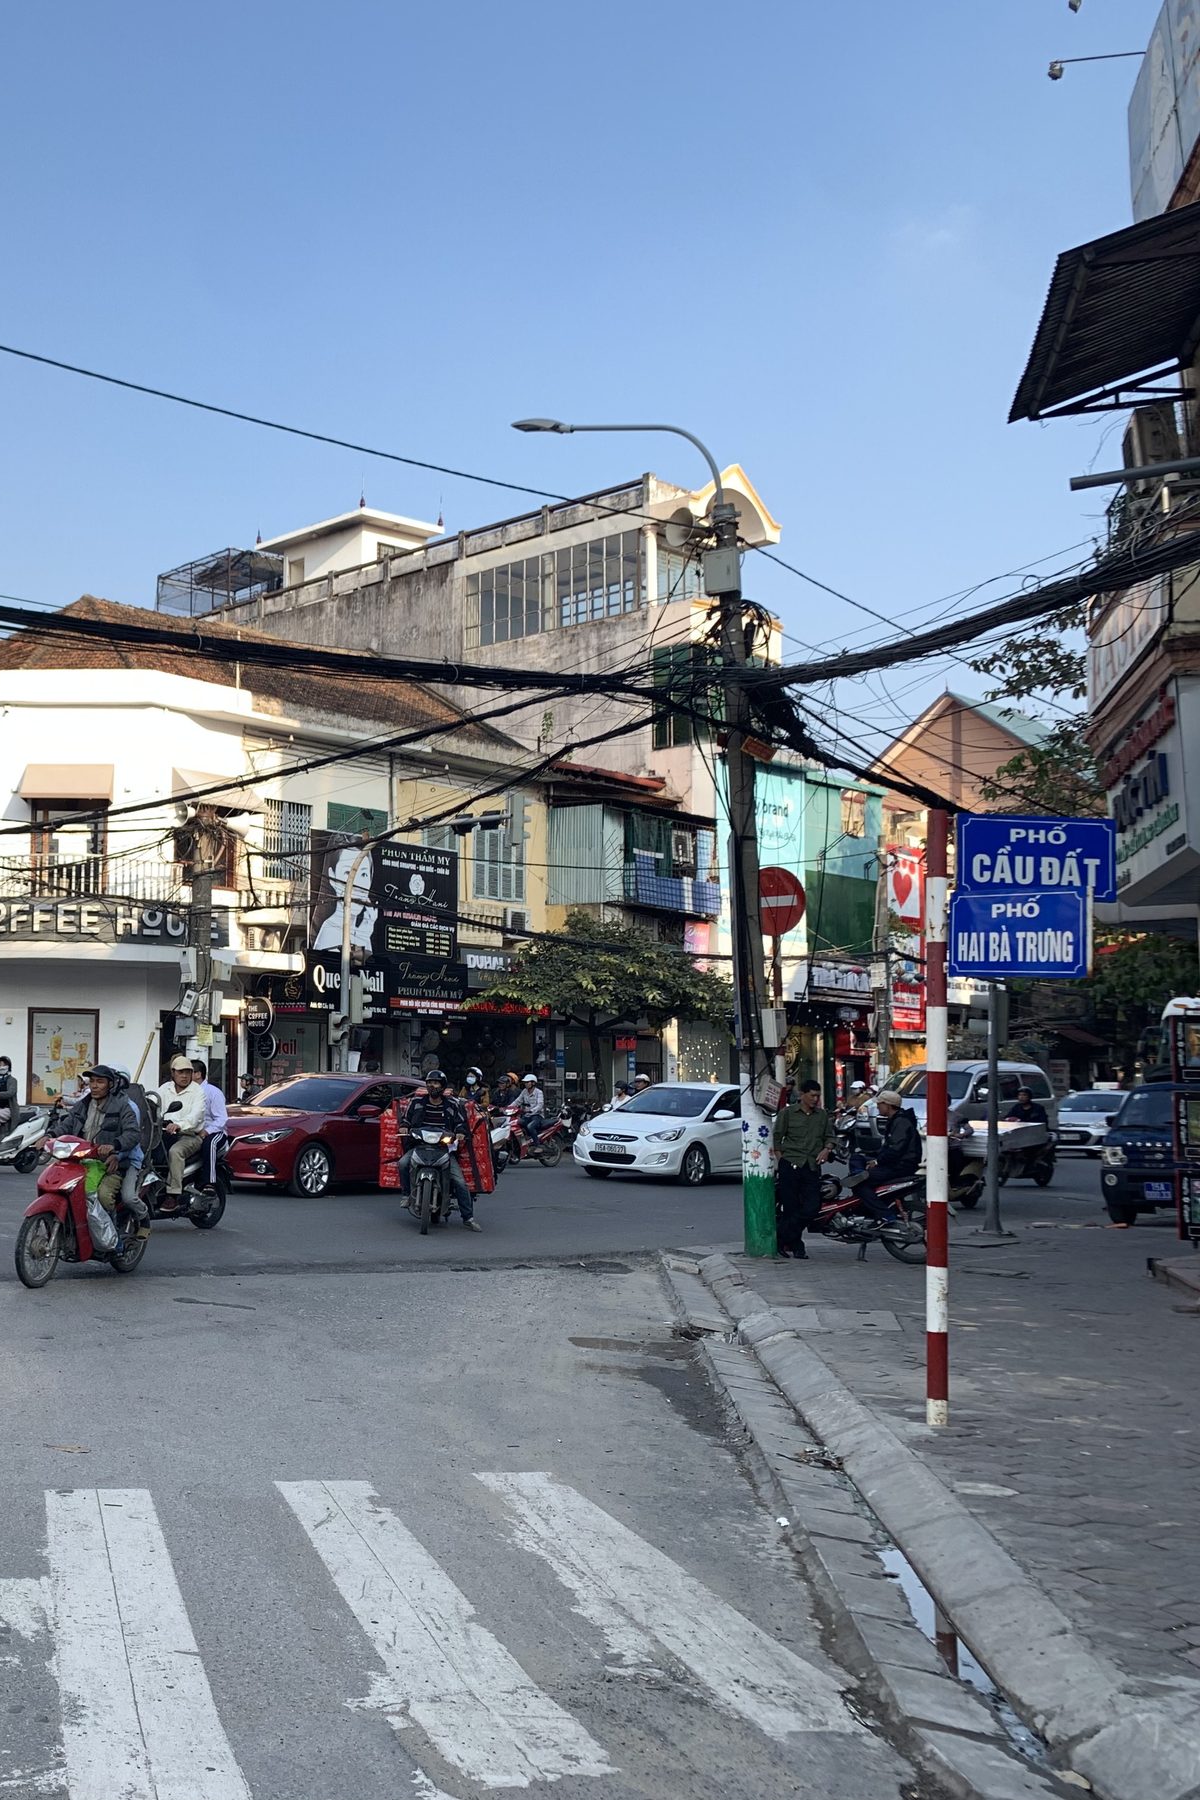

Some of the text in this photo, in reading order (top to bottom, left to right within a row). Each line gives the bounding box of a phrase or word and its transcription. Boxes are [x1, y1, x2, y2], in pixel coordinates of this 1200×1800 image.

[1009, 823, 1069, 844] PHỐ
[381, 848, 407, 860] PHUN
[409, 849, 435, 864] THẨM
[972, 845, 1035, 885] CẦU
[1039, 848, 1101, 887] ĐẤT
[991, 894, 1041, 918] PHỐ
[958, 925, 1074, 963] HAI BÀ TRƯNG
[247, 1012, 268, 1020] COFFEE
